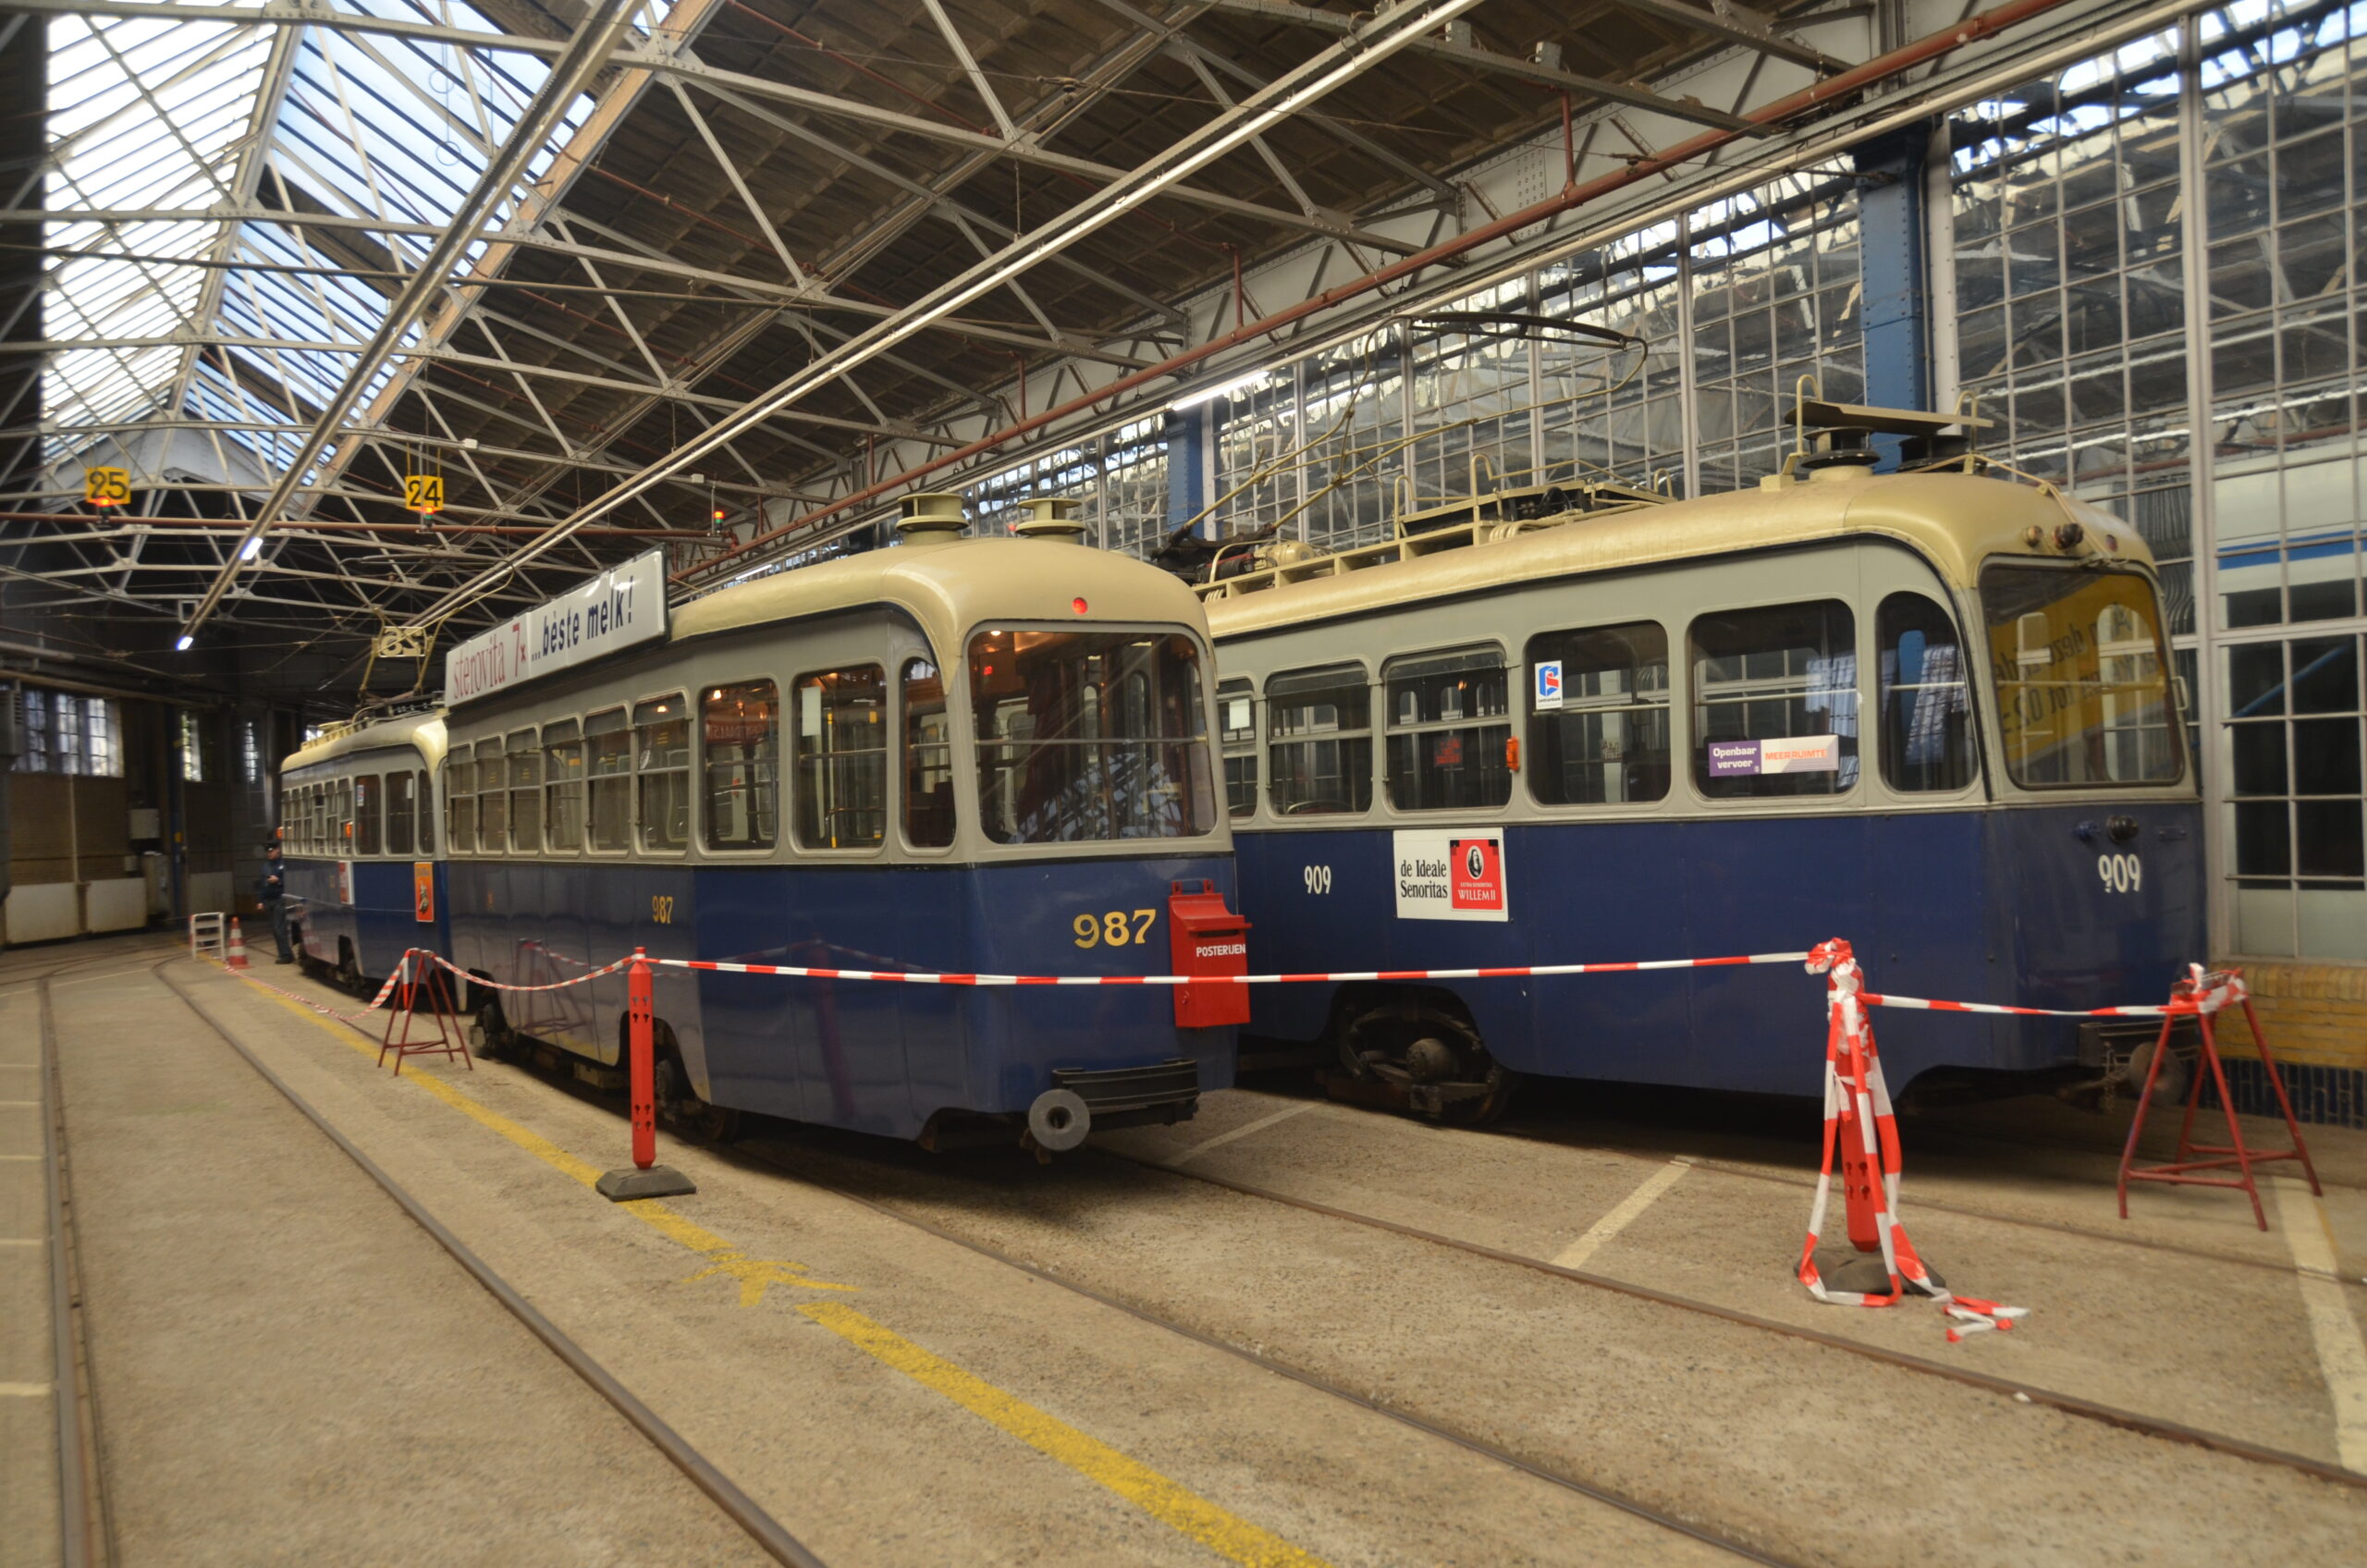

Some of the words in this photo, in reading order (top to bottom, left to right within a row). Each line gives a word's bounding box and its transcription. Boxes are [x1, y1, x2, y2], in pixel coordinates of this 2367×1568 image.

[90, 472, 127, 500] 25
[409, 480, 441, 508] 24
[454, 633, 505, 699] sterovita
[587, 575, 633, 640] melk!
[1713, 746, 1757, 759] Openbaar
[1717, 759, 1753, 769] vervoer
[1764, 751, 1791, 761] MEER
[1792, 748, 1827, 759] RUIMTE
[1305, 865, 1331, 894] 909
[1400, 859, 1413, 877] de
[1416, 859, 1447, 877] Ideale
[2098, 853, 2140, 893] 909
[1401, 880, 1448, 899] Senoritas
[1458, 889, 1490, 900] WILLEM
[652, 895, 673, 924] 987
[1073, 909, 1156, 949] 987
[1196, 943, 1246, 958] POSTERIJEN
